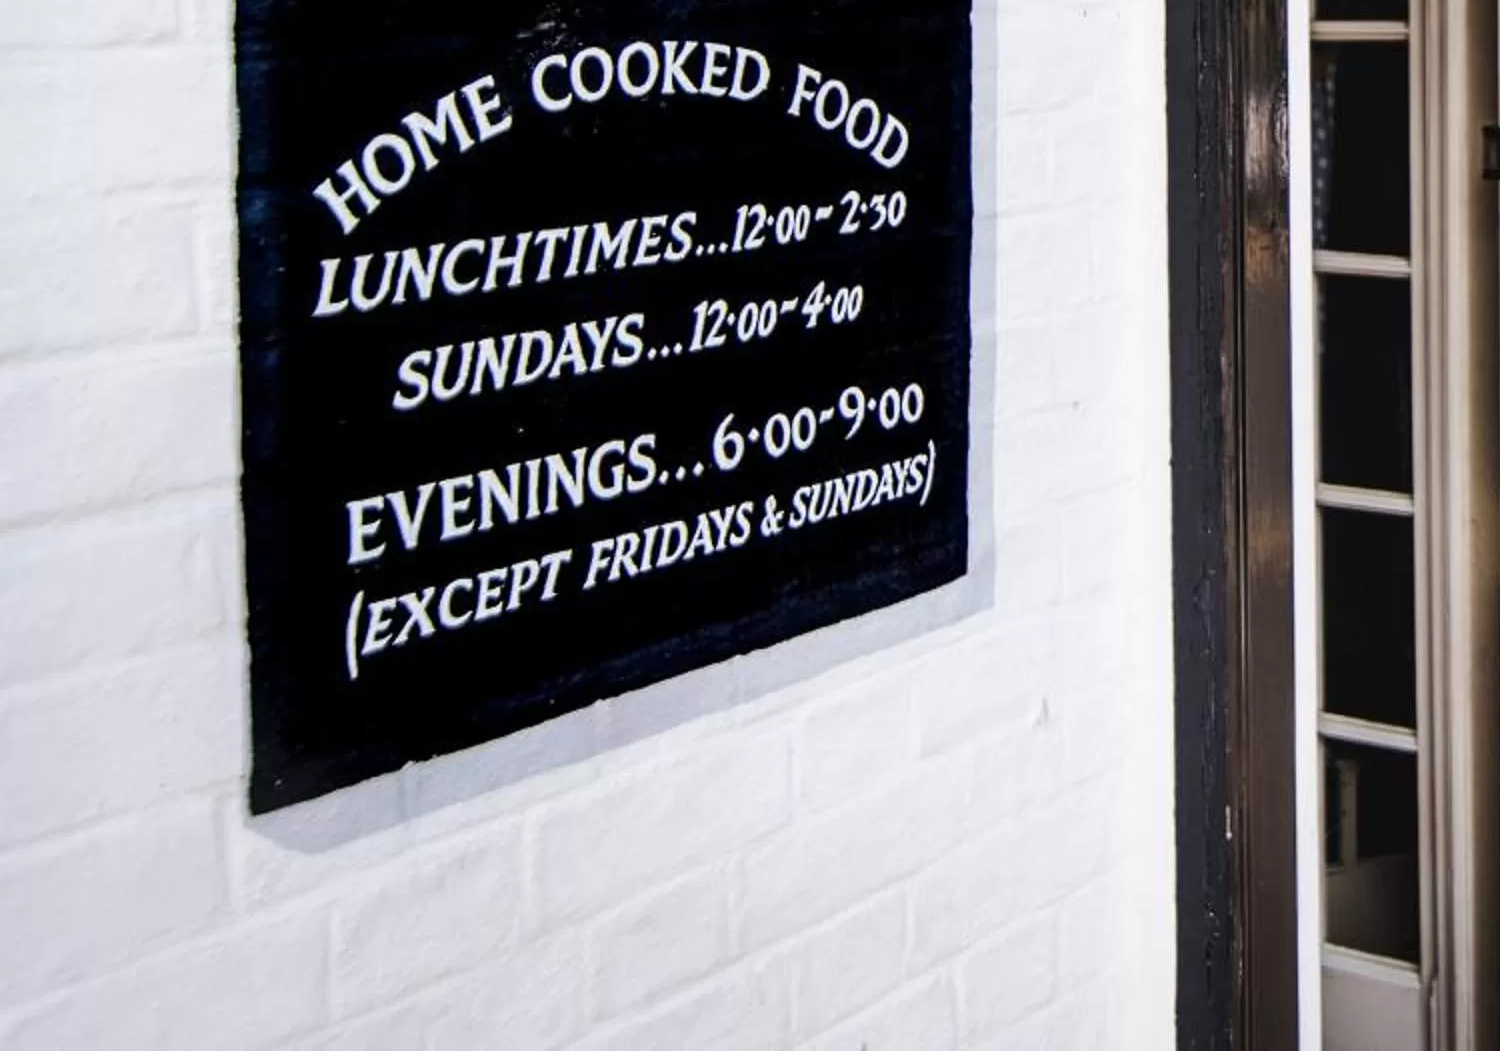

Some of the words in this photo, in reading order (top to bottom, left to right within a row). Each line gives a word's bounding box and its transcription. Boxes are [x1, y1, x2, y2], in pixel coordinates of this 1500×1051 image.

[313, 75, 512, 234] HOME
[532, 41, 770, 111] COOKED
[788, 64, 908, 168] FOOD
[346, 549, 572, 679] (EXCEPT
[583, 501, 753, 589] FRIDAYS
[760, 495, 784, 537] &
[788, 440, 936, 528] SUNDAYS)
